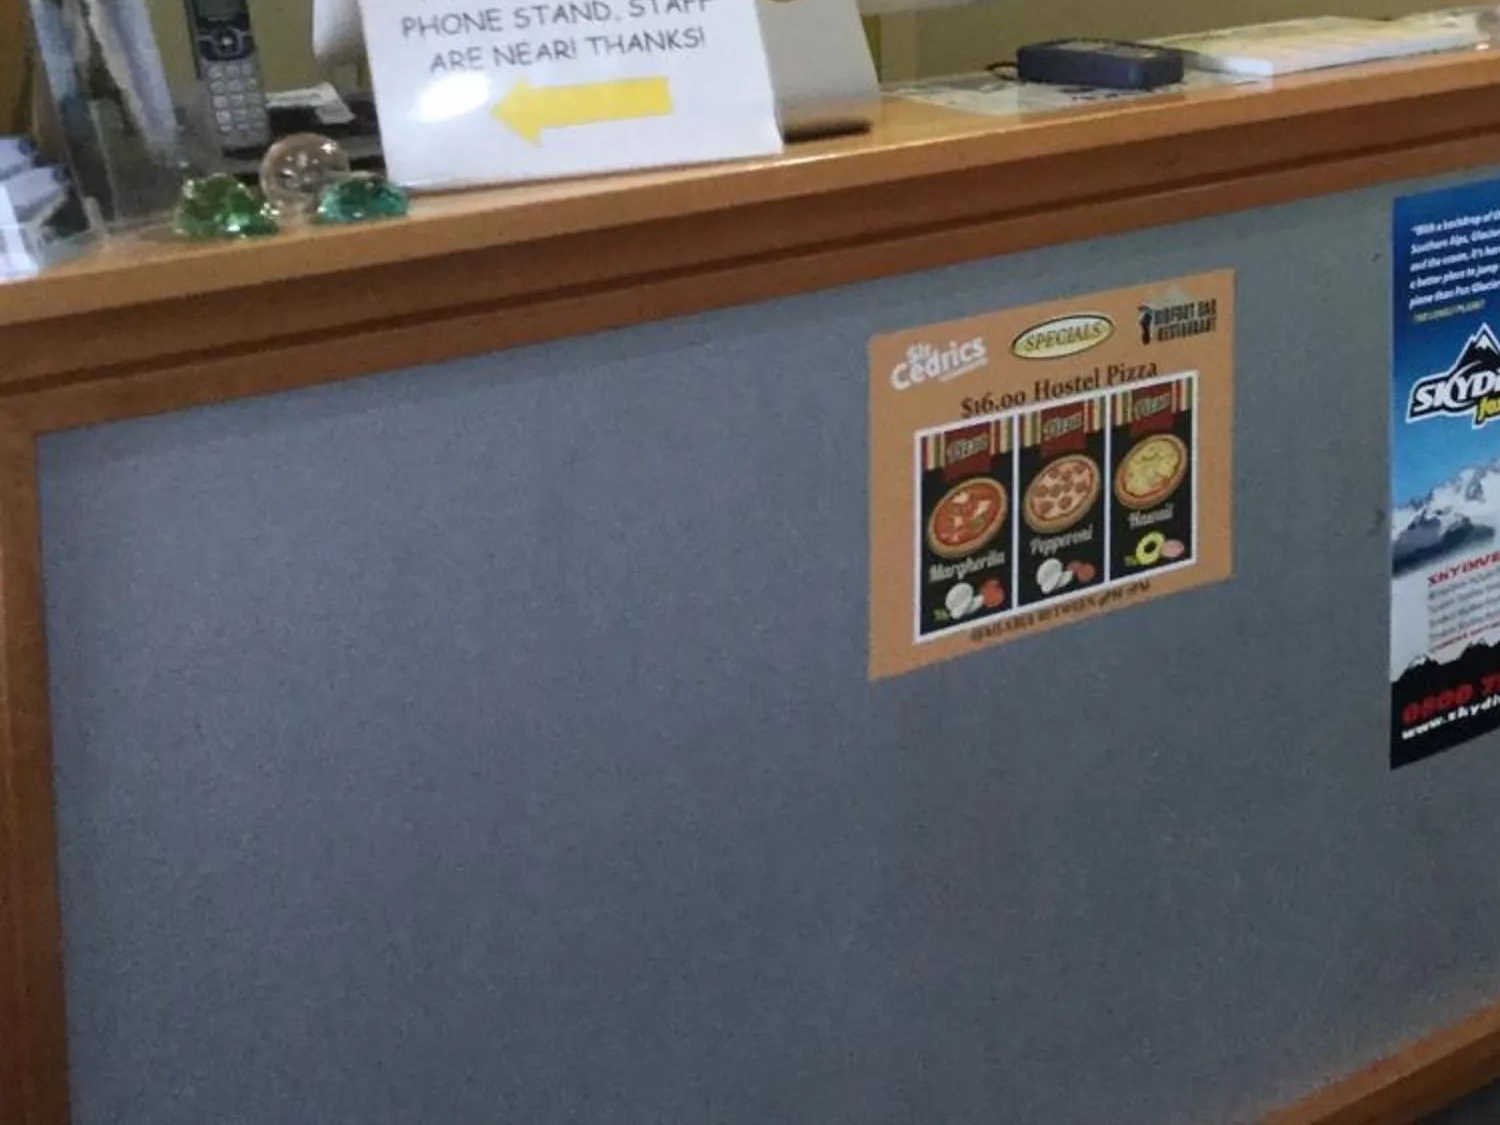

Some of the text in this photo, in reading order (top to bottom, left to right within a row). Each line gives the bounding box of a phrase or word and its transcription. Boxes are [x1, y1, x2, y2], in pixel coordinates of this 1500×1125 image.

[401, 8, 504, 38] PHONE
[430, 26, 706, 73] ARE NEAR! THANKS!
[1417, 275, 1442, 288] better
[1442, 271, 1465, 284] place
[1476, 263, 1499, 278] jump
[1409, 294, 1433, 311] plane
[1434, 289, 1455, 302] than
[1022, 321, 1104, 353] SPECIALS
[891, 336, 988, 391] Cedrics
[959, 361, 1158, 419] $16.00 Hostel Pizza
[1028, 524, 1094, 556] Pepperoni
[1402, 683, 1474, 724] 0800
